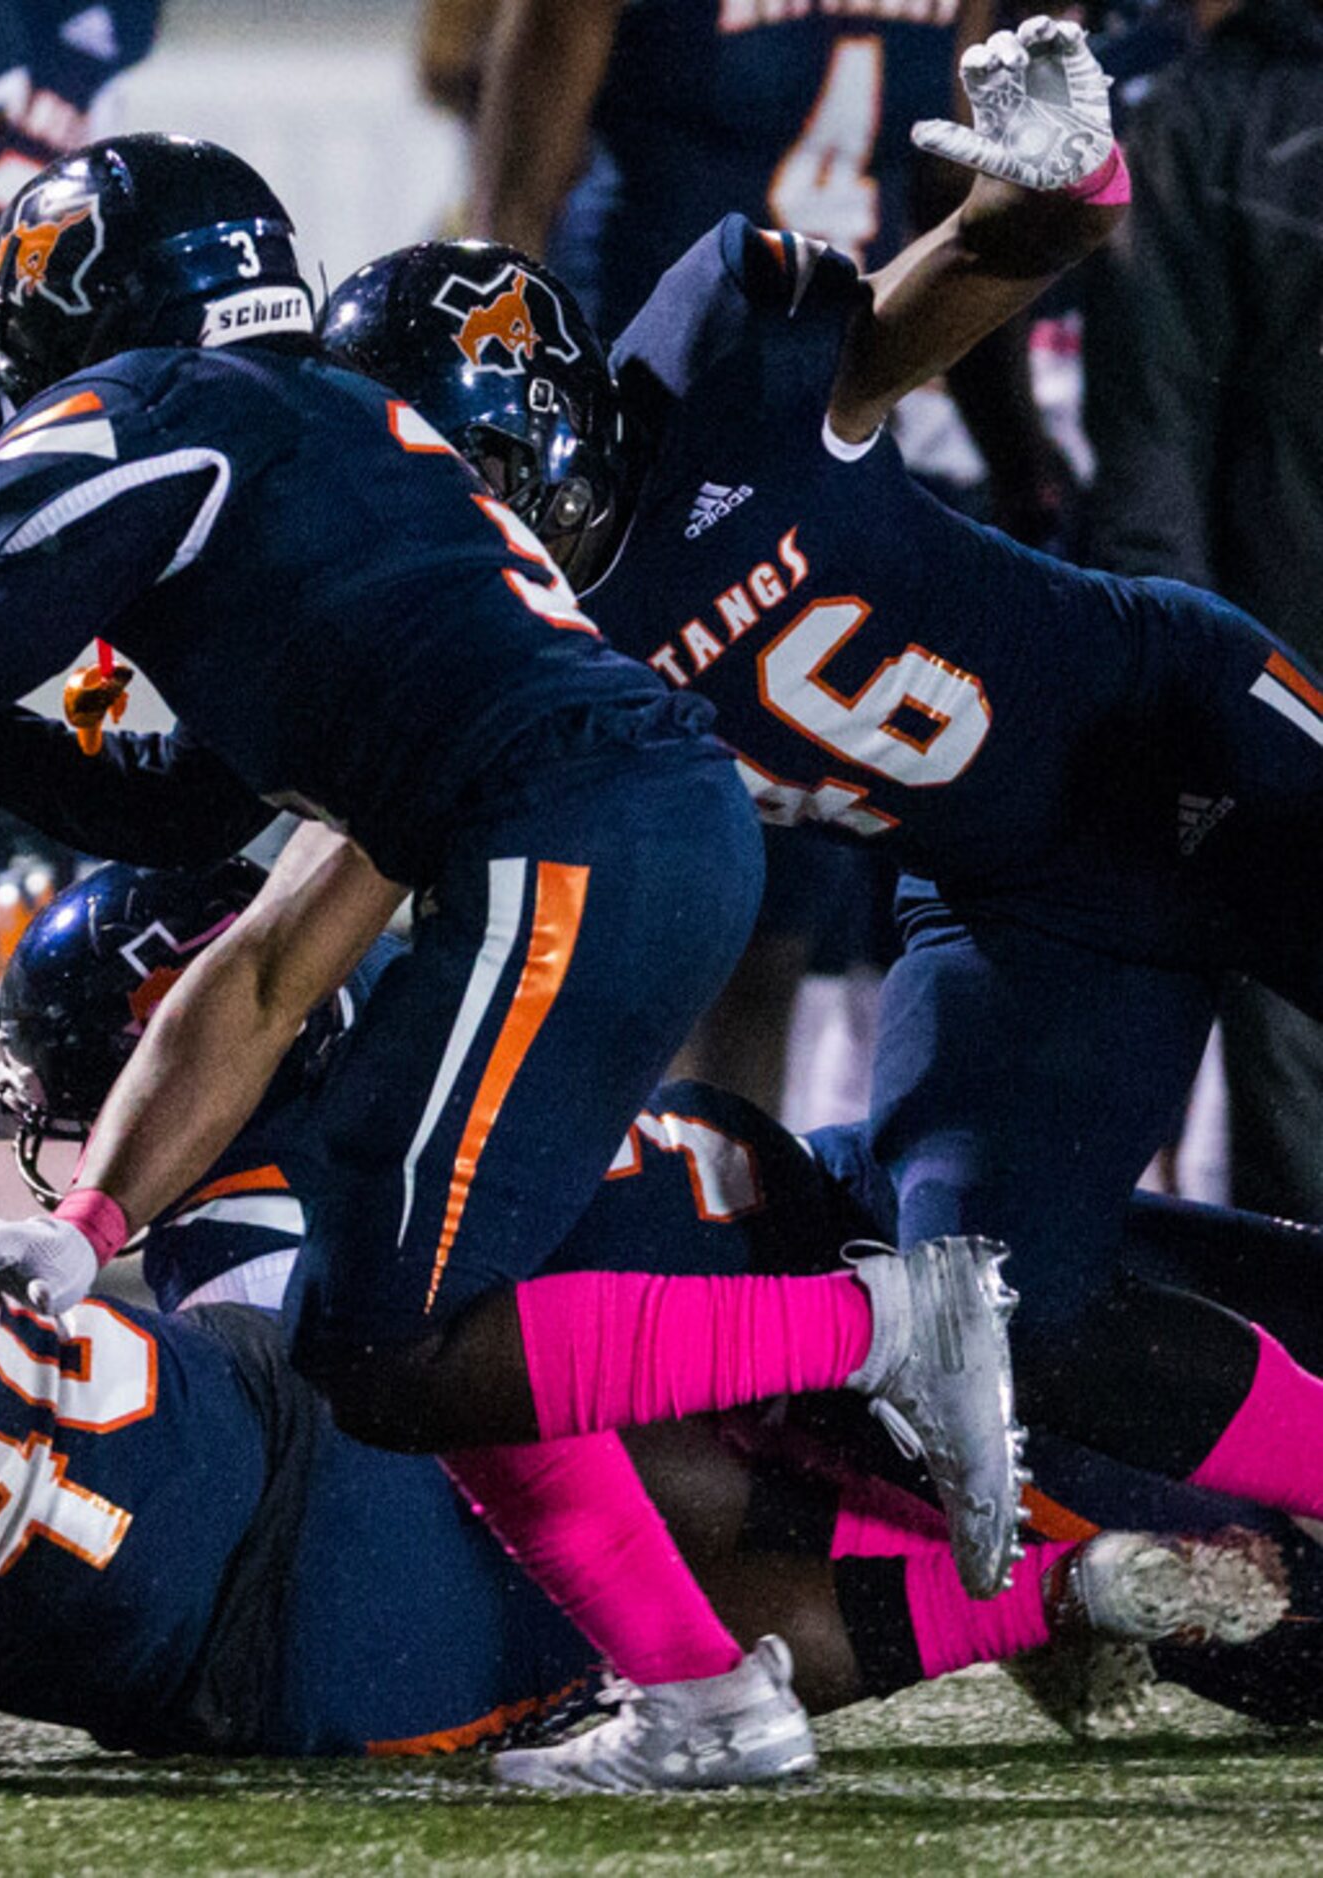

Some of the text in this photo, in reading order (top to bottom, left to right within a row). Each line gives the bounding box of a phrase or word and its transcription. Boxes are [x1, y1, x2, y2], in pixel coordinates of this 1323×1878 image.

[766, 33, 884, 274] 4
[227, 230, 260, 278] 3
[684, 485, 753, 540] adidas
